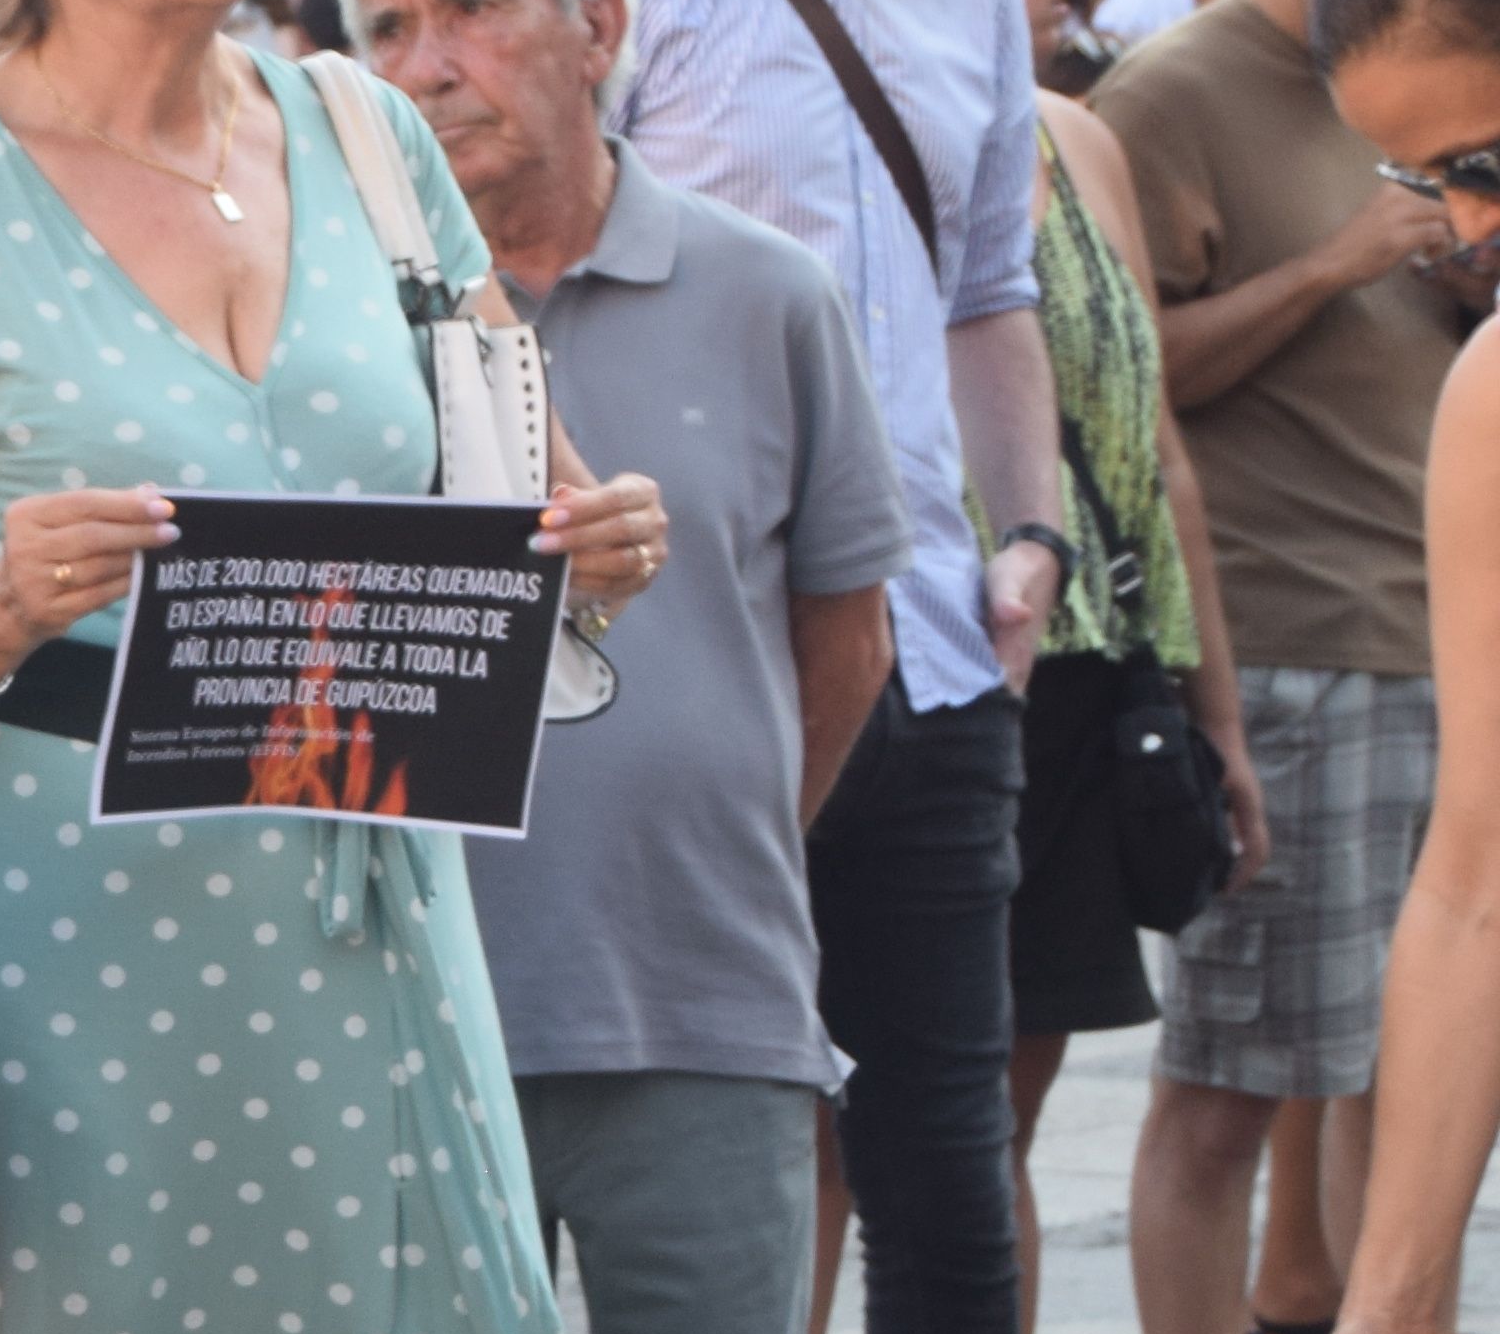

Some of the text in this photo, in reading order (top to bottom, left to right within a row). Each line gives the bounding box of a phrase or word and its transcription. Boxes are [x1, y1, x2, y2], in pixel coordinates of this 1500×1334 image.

[156, 557, 543, 603] MÁS DE 200.000 HECTÁREAS QUEMADAS
[167, 593, 513, 642] EN ESPAÑA EN LO QUE LLEVAMOS DE
[214, 637, 240, 666] LO
[241, 638, 282, 667] QUE
[282, 639, 381, 669] EQUIVALE
[381, 643, 397, 670] A
[402, 643, 455, 675] TODA
[459, 648, 489, 680] LA
[193, 676, 438, 715] PROVINCIA DE GUIPÚZCOA
[240, 722, 258, 738] de
